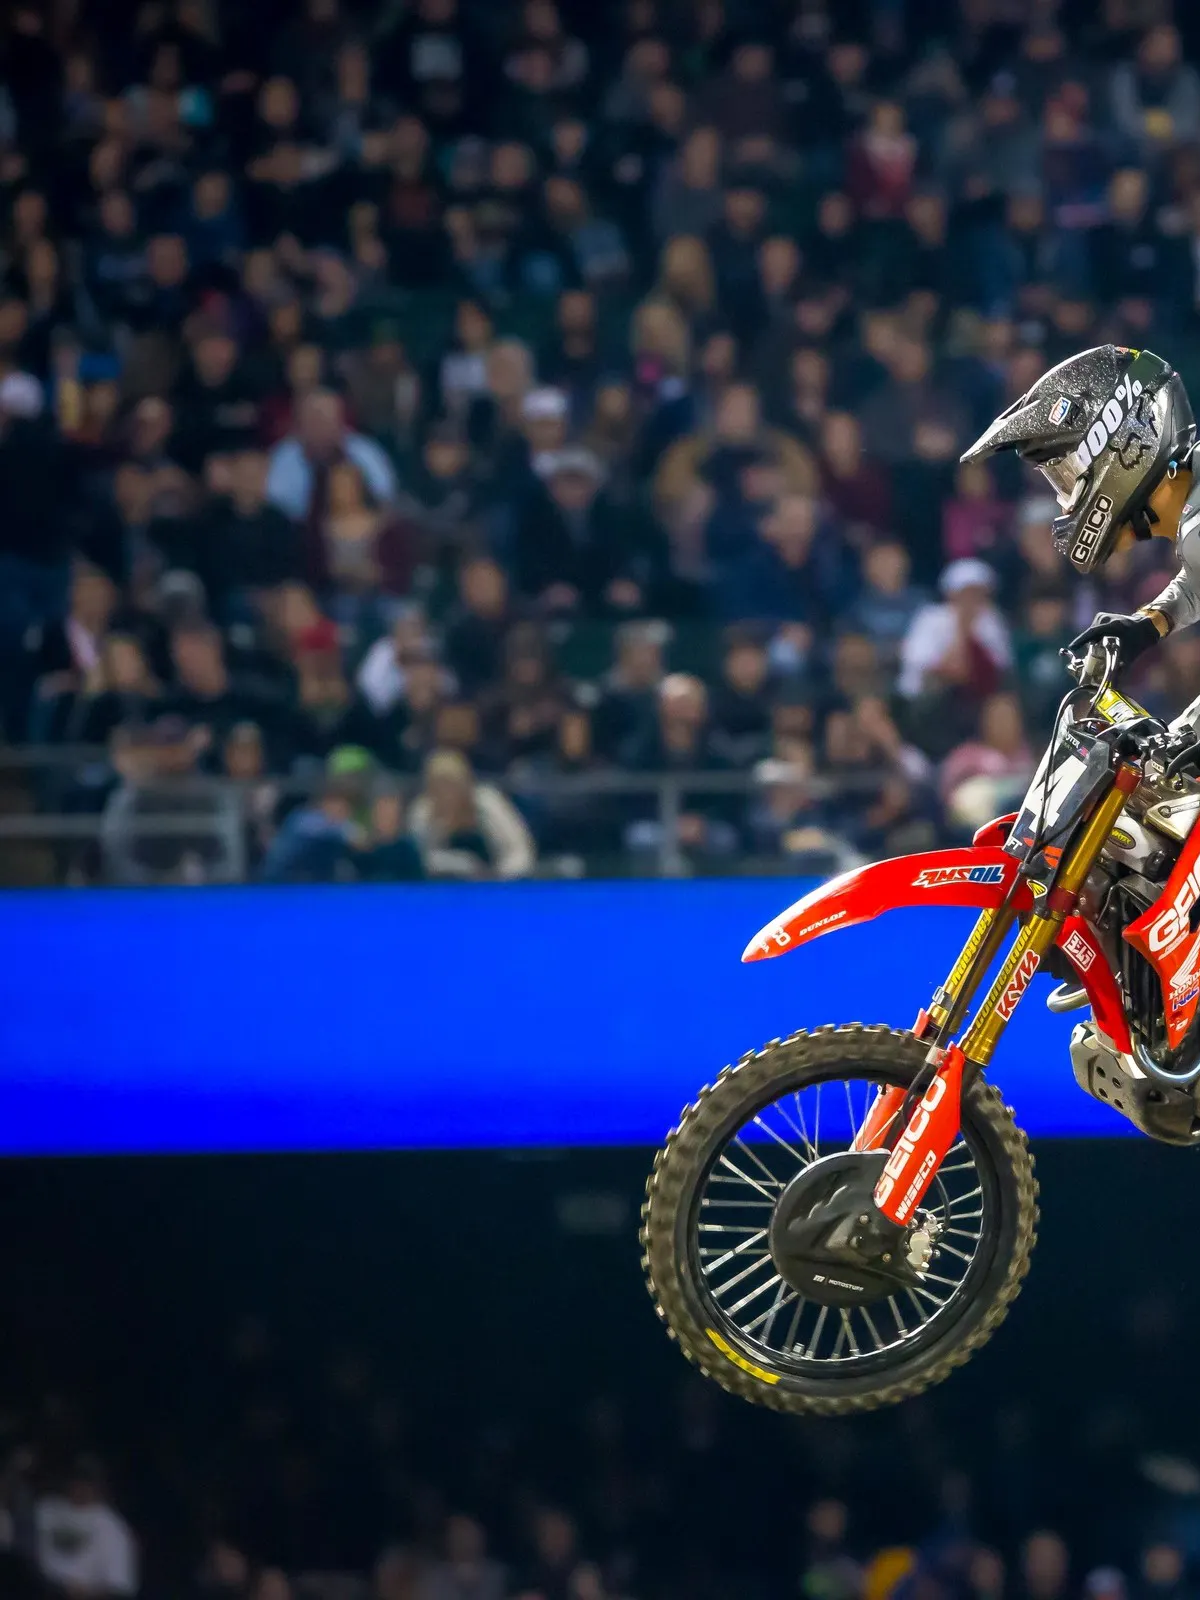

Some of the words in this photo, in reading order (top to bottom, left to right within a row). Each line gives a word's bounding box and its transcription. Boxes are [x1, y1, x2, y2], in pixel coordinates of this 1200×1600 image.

[1076, 373, 1143, 468] 100%
[1070, 494, 1114, 564] GEICO
[912, 865, 1005, 888] AMSOIL
[799, 910, 847, 937] DUNLOP
[995, 949, 1041, 1022] KYB
[873, 1074, 947, 1209] GEICO
